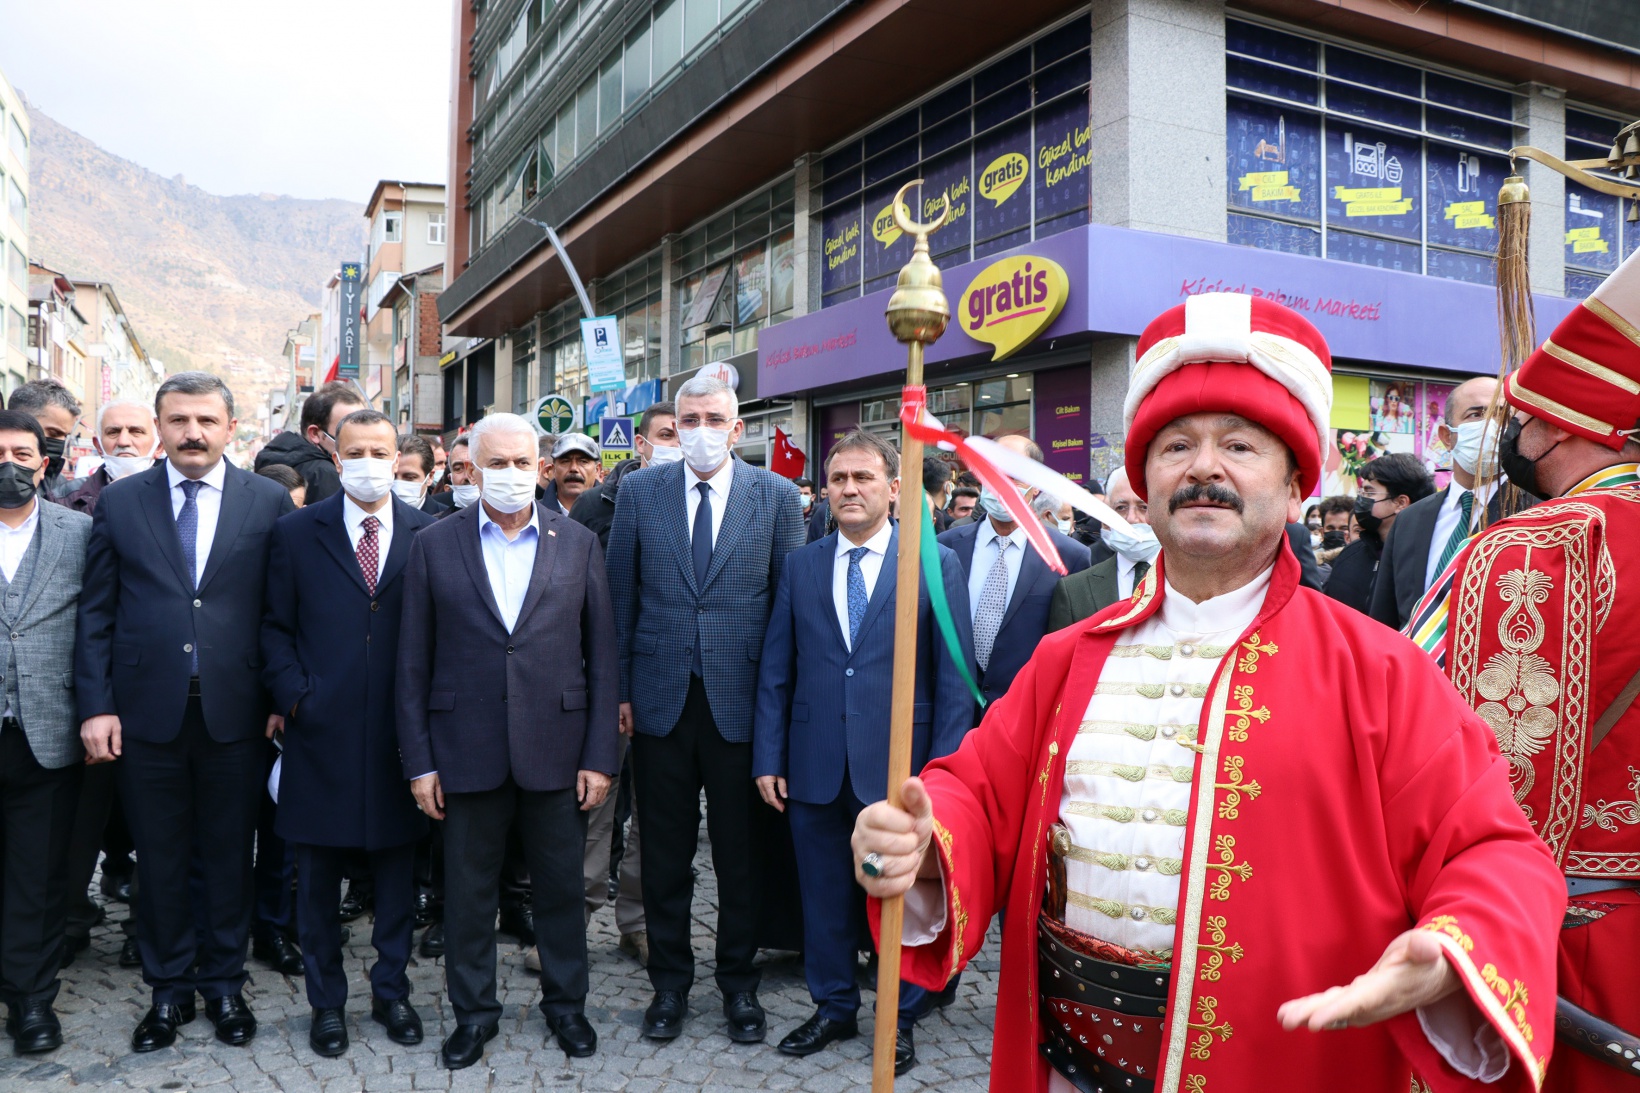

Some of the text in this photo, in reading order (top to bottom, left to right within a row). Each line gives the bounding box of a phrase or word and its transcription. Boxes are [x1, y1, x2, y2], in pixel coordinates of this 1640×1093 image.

[1038, 127, 1092, 169] Güzel ba
[984, 156, 1023, 194] gratis
[1046, 149, 1093, 188] kendine
[951, 176, 970, 202] bak
[825, 220, 860, 256] Güzel bak
[828, 244, 857, 270] kendine
[968, 261, 1048, 331] gratis
[1314, 298, 1382, 321] Marketi
[596, 328, 605, 340] P
[1056, 405, 1080, 415] Cilt Bakım
[604, 452, 621, 460] İLK
[1052, 440, 1067, 449] Kişisel
[1068, 439, 1083, 447] Bakım
